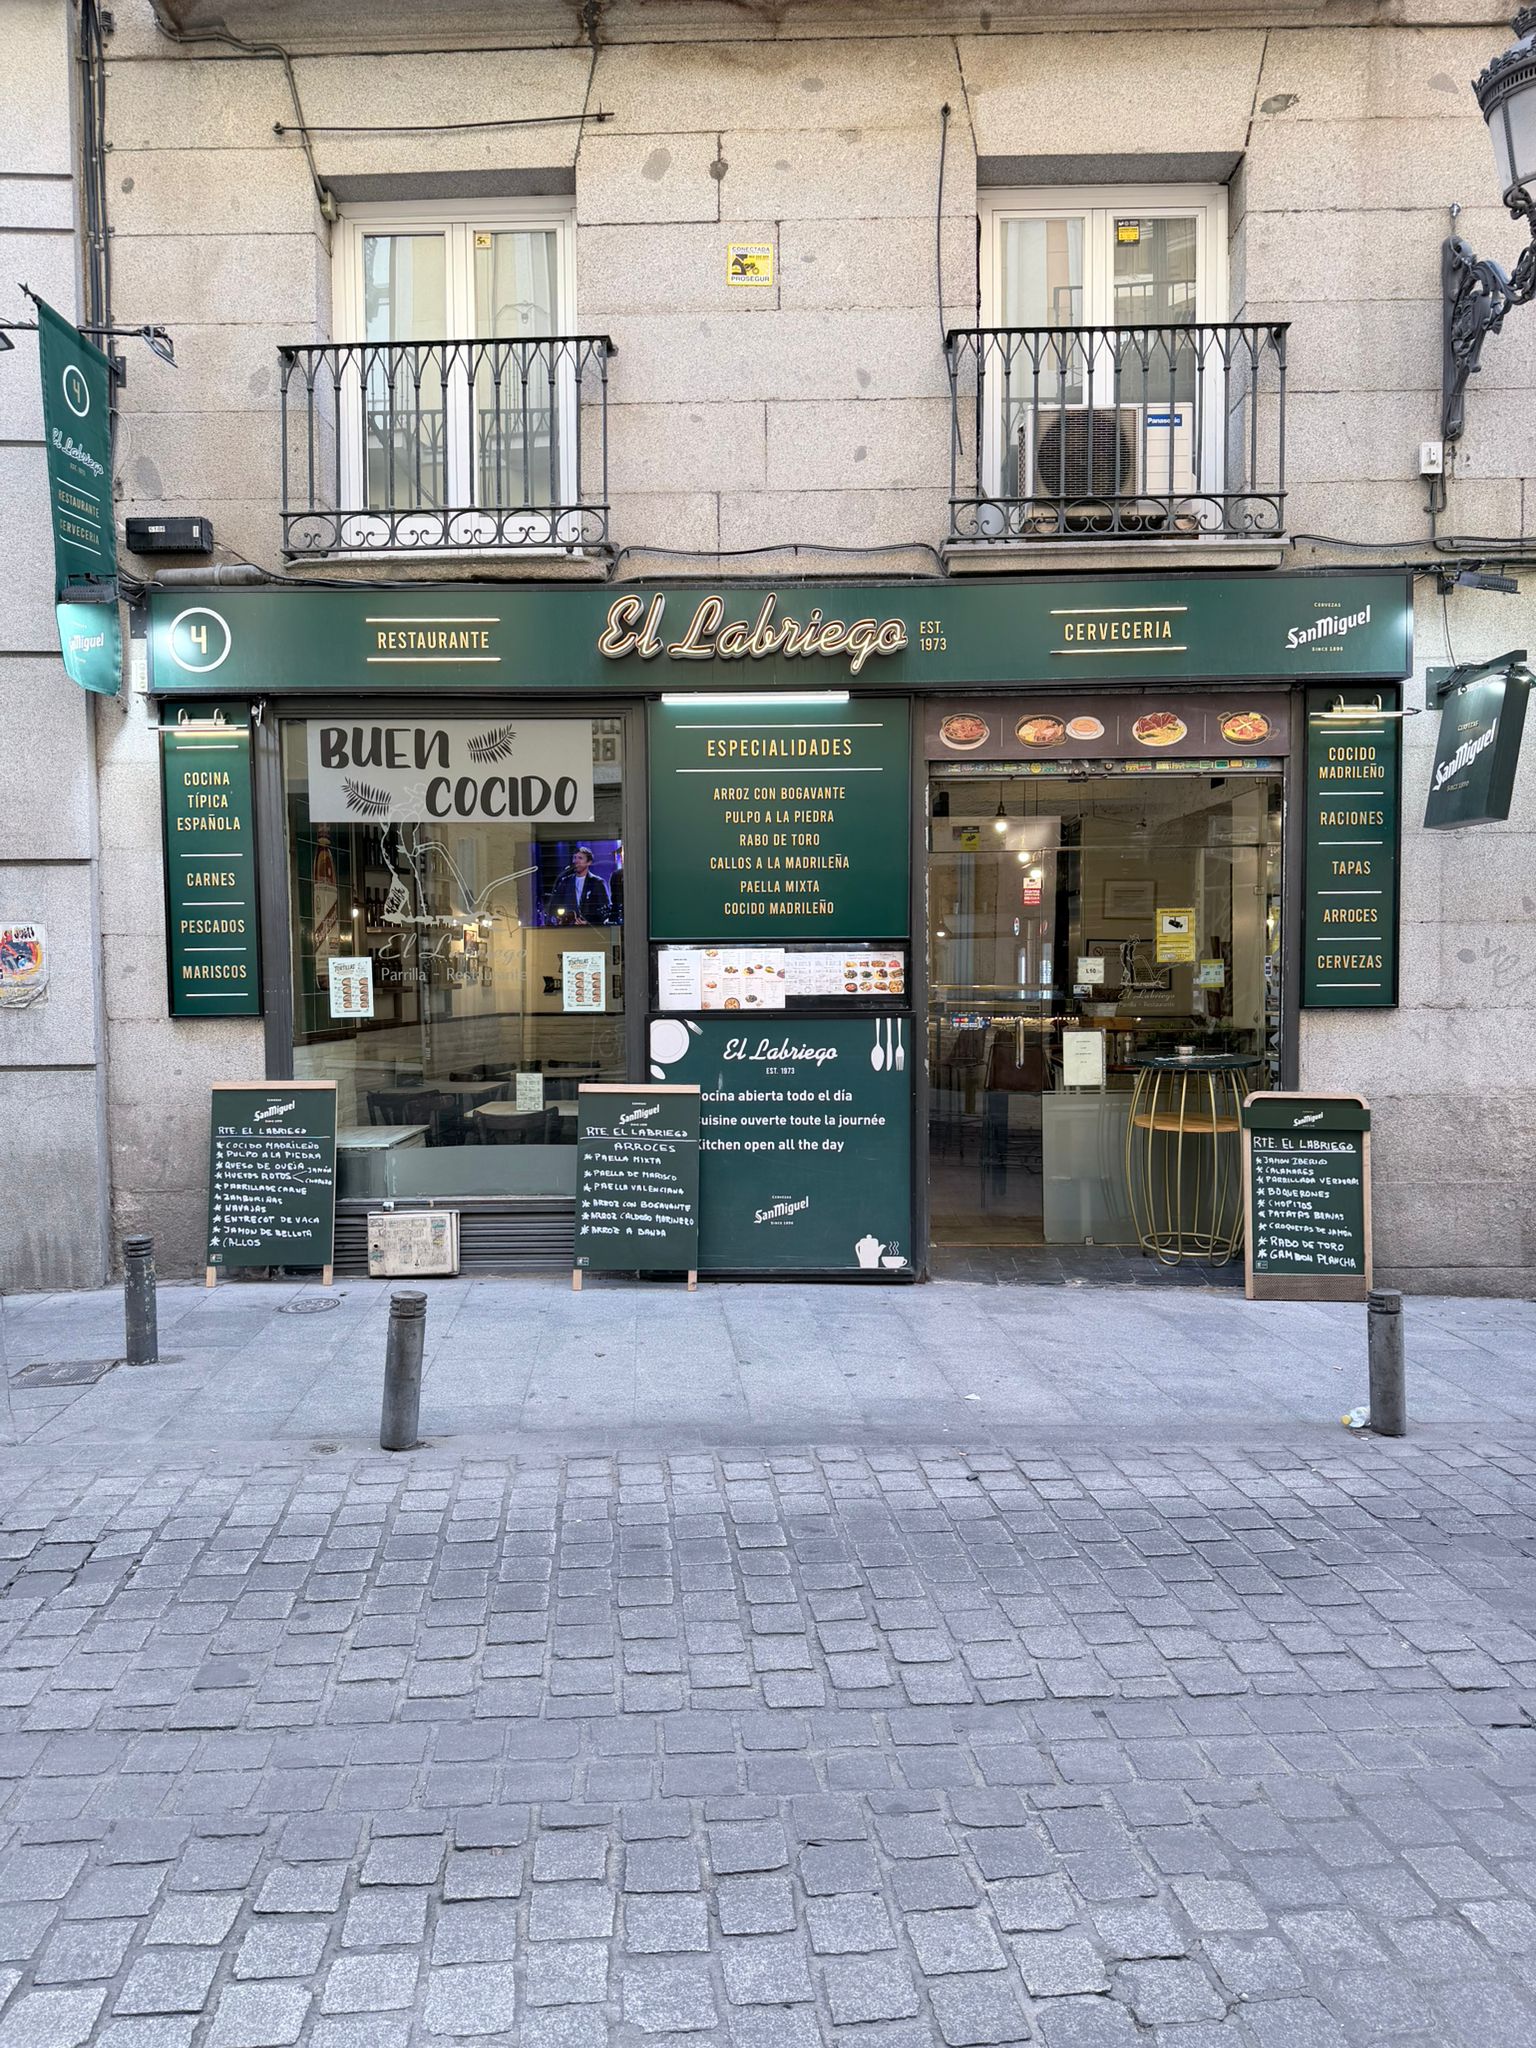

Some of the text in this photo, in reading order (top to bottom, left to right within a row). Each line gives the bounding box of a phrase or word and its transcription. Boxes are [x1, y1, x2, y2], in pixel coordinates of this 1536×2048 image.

[73, 379, 82, 404] 4
[52, 427, 104, 477] El Labriego
[58, 489, 100, 519] RESTAURANTE
[59, 519, 100, 545] CERVECERIA
[597, 591, 909, 677] El Labriego
[919, 621, 944, 634] EST.
[1064, 620, 1172, 642] CERVECERIA
[190, 624, 208, 655] 4
[377, 631, 490, 649] RESTAURANTE
[919, 637, 947, 652] 1973
[319, 726, 451, 770] BUEN
[706, 738, 853, 758] ESPECIALIDADES
[1328, 747, 1377, 762] COCIDO
[1319, 762, 1385, 780] MADRILEÑO
[183, 771, 231, 787] COCINA
[187, 790, 229, 809] TÍPICA
[424, 776, 578, 818] COCIDO
[713, 786, 846, 801] ARROZ CON BOGAVANTE
[176, 812, 241, 832] ESPAÑOLA
[725, 809, 834, 824] PULPO A LA PIEDRA
[1319, 811, 1384, 826] RACIONES
[739, 833, 820, 846] RABO DE TORO
[710, 853, 850, 869] CALLOS A LA MADRILEÑA
[1332, 860, 1371, 876] TAPAS
[186, 871, 236, 888] CARNES
[740, 880, 820, 893] PAELLA MIXTA
[724, 899, 834, 915] COCIDO MADRILEÑO
[1323, 908, 1378, 923] ARROCES
[180, 918, 246, 934] PESCADOS
[378, 932, 418, 960] El
[1317, 954, 1383, 970] CERVEZAS
[182, 963, 248, 980] MARISCOS
[381, 967, 427, 981] Parrilla
[722, 1037, 838, 1067] El Labriego
[766, 1067, 796, 1075] EST. 1973
[701, 1088, 853, 1102] ocina abierta todo el día
[699, 1113, 886, 1128] uisine ouverte toute la journée
[242, 1127, 254, 1135] EL
[259, 1127, 307, 1135] LABRIEGO
[613, 1127, 628, 1136] EL
[631, 1128, 688, 1138] LABRIEGO
[225, 1141, 263, 1150] COCIDO
[614, 1142, 676, 1153] ARROCES
[744, 1141, 775, 1153] open
[778, 1138, 795, 1150] all
[798, 1138, 819, 1150] the
[822, 1138, 845, 1153] day
[1253, 1136, 1354, 1151] RTE. EL LABRIEGO
[226, 1150, 322, 1160] PULPO A LA PIEDRA
[594, 1153, 661, 1165] PAELLA MIXTA
[1262, 1156, 1290, 1165] JAMON
[224, 1161, 254, 1170] QUESO
[256, 1162, 271, 1170] DE
[1265, 1166, 1315, 1176] CALAMARES
[224, 1171, 292, 1180] HUEVOS ROTOS
[593, 1169, 624, 1177] PAELLA
[642, 1171, 677, 1182] MARISCO
[1265, 1175, 1316, 1184] PARRILLADA
[277, 1186, 307, 1196] CARNE
[594, 1182, 684, 1195] PAELLA VALENCIANA
[1267, 1187, 1330, 1199] BOQUERONES
[223, 1193, 283, 1205] ZAMBURIÑAS
[592, 1198, 620, 1208] ARROZ
[622, 1200, 637, 1208] CON
[1268, 1199, 1313, 1210] CHOPITOS
[224, 1204, 267, 1213] NAVAJAS
[1268, 1209, 1311, 1219] PATATAS
[224, 1215, 320, 1224] ENTRECOT DE VACA
[590, 1211, 618, 1220] ARROZ
[655, 1214, 695, 1226] MARINERO
[223, 1226, 313, 1238] JAMON DE BELLOTA
[591, 1225, 667, 1237] ARROZ A BANDA
[1269, 1221, 1314, 1233] CROQUETAS
[1315, 1226, 1326, 1235] DE
[222, 1237, 261, 1248] CALLOS
[1269, 1235, 1345, 1252] RABO DE TORO
[1269, 1249, 1357, 1269] GAMBON PLANCHA
